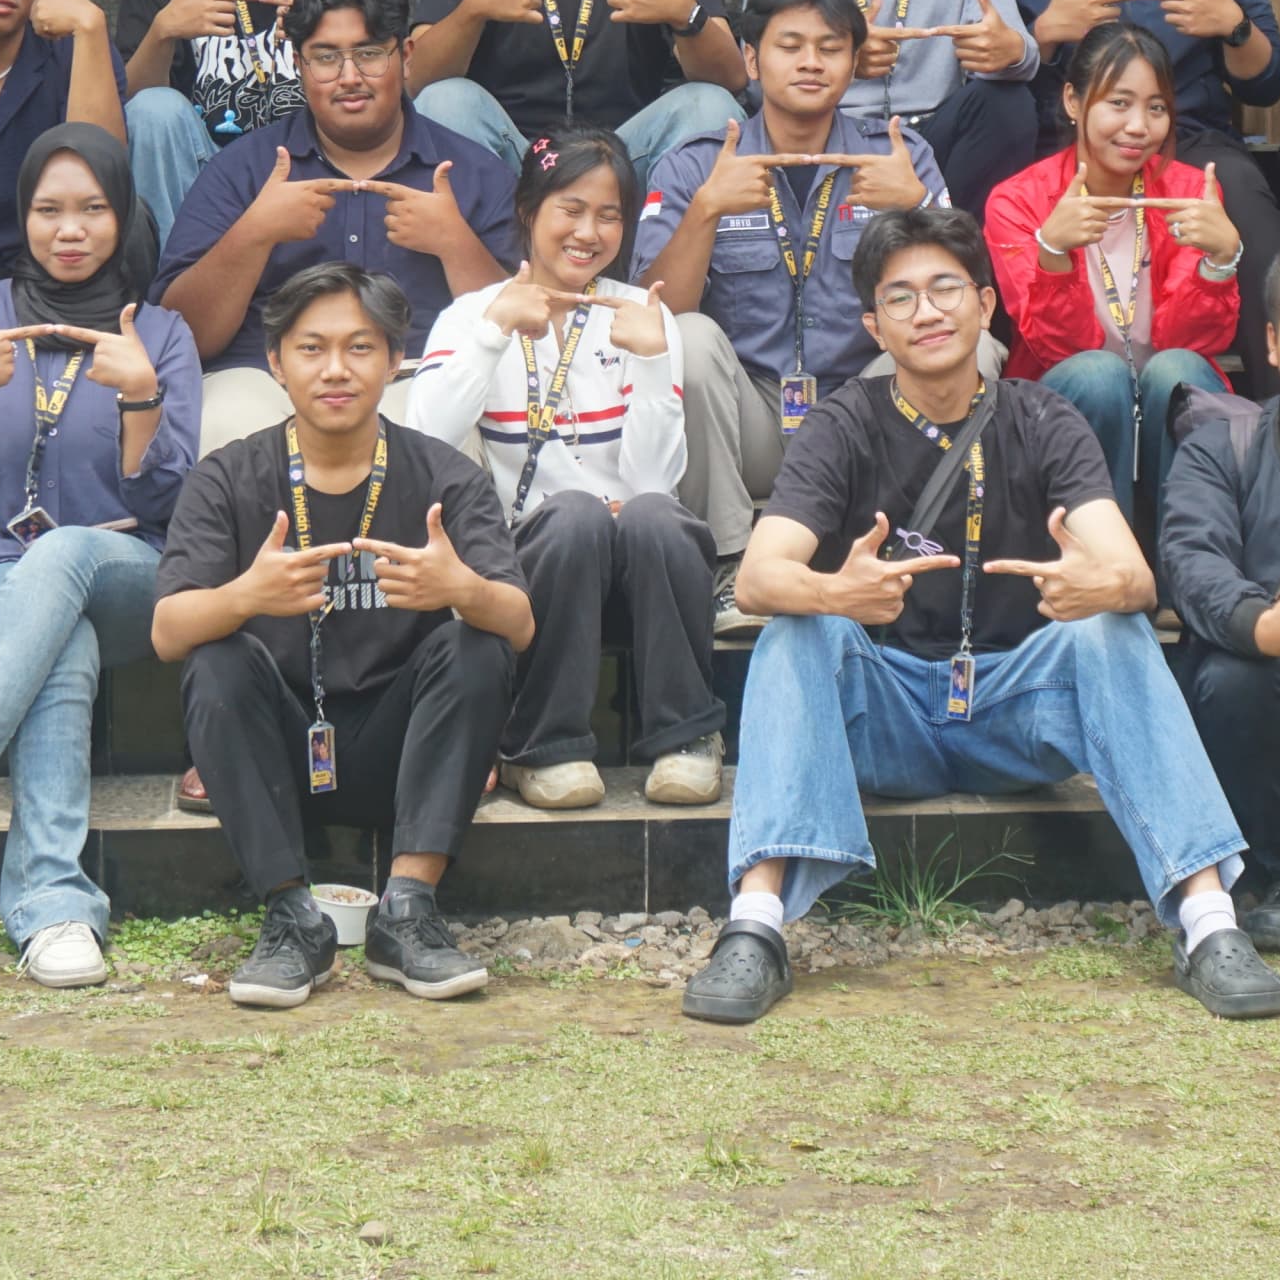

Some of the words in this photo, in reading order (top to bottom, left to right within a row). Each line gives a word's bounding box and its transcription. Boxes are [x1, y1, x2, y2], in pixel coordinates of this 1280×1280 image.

[811, 210, 826, 237] HMTI
[551, 363, 570, 393] HMTI
[561, 328, 582, 365] UDINUS
[293, 486, 308, 532] UDINUS
[366, 481, 383, 512] HMTI
[319, 582, 389, 611] FUTUR
